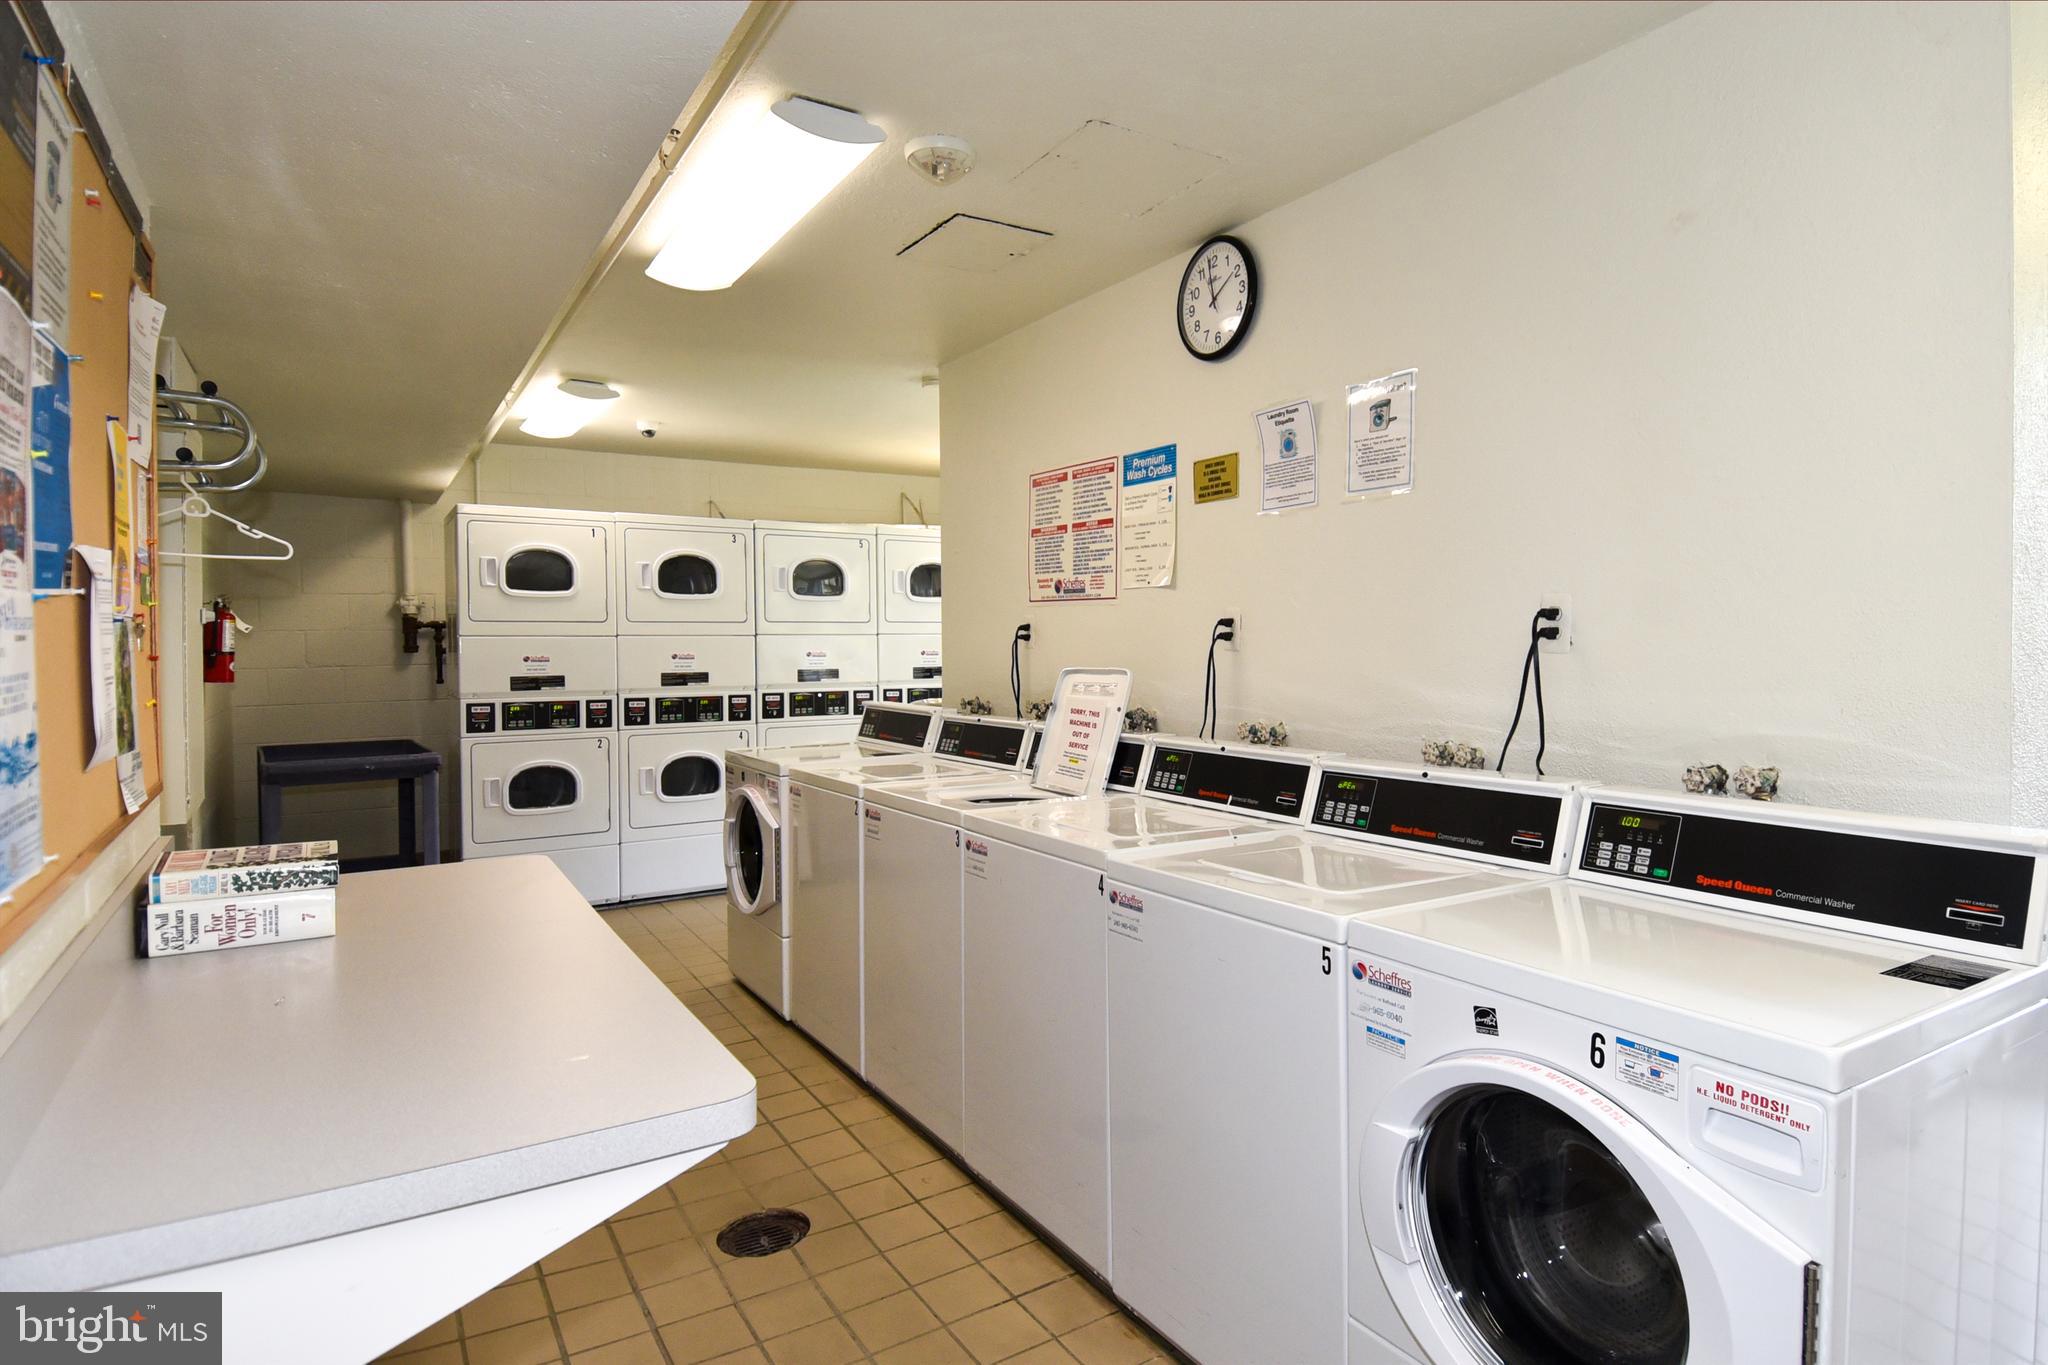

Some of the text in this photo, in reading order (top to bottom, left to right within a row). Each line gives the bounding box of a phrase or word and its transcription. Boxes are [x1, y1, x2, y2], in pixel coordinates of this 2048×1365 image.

[1225, 254, 1230, 267] 1
[1233, 264, 1241, 278] 2
[1189, 287, 1200, 301] 10
[1238, 280, 1246, 294] 3
[1188, 305, 1195, 318] 9
[1236, 301, 1243, 313] 4
[1194, 320, 1201, 332] 8
[1203, 330, 1210, 343] 7
[1214, 332, 1222, 344] 6
[1267, 407, 1299, 420] Laundry Room
[1275, 416, 1295, 427] Etiquette
[1132, 454, 1166, 469] Premium
[1127, 468, 1146, 480] Wash
[1148, 464, 1173, 478] Cycles
[591, 527, 596, 538] 1
[731, 534, 737, 544] 3
[858, 539, 864, 549] 5
[1063, 577, 1086, 589] Scheffres
[1070, 707, 1100, 718] SORRY, THIS
[1069, 719, 1091, 729] MACHINE
[738, 730, 743, 740] 4
[1072, 730, 1082, 738] OUT
[597, 738, 603, 749] 2
[1068, 742, 1089, 751] SERVICE
[854, 801, 859, 816] 2
[955, 829, 960, 848] 3
[1437, 832, 1466, 843] Commercial
[1466, 837, 1484, 846] Washer
[1098, 874, 1104, 896] 4
[1696, 874, 1856, 910] Speed Queen Commercial Washer
[170, 909, 184, 951] & Barbara
[185, 912, 199, 944] Seaman
[204, 913, 223, 933] For
[218, 904, 237, 946] Women
[238, 907, 262, 939] Only!
[155, 912, 173, 951] Gary Null
[1322, 946, 1332, 975] 5
[1368, 965, 1412, 991] Scheffres
[1590, 1032, 1606, 1069] 6
[1634, 1043, 1660, 1056] NOTICE
[1545, 1072, 1589, 1095] WHEN
[1591, 1097, 1633, 1128] DONE
[1715, 1081, 1790, 1116] NO PODS!!
[1696, 1086, 1811, 1132] H.E. LIQUID DETERGENT ONLY
